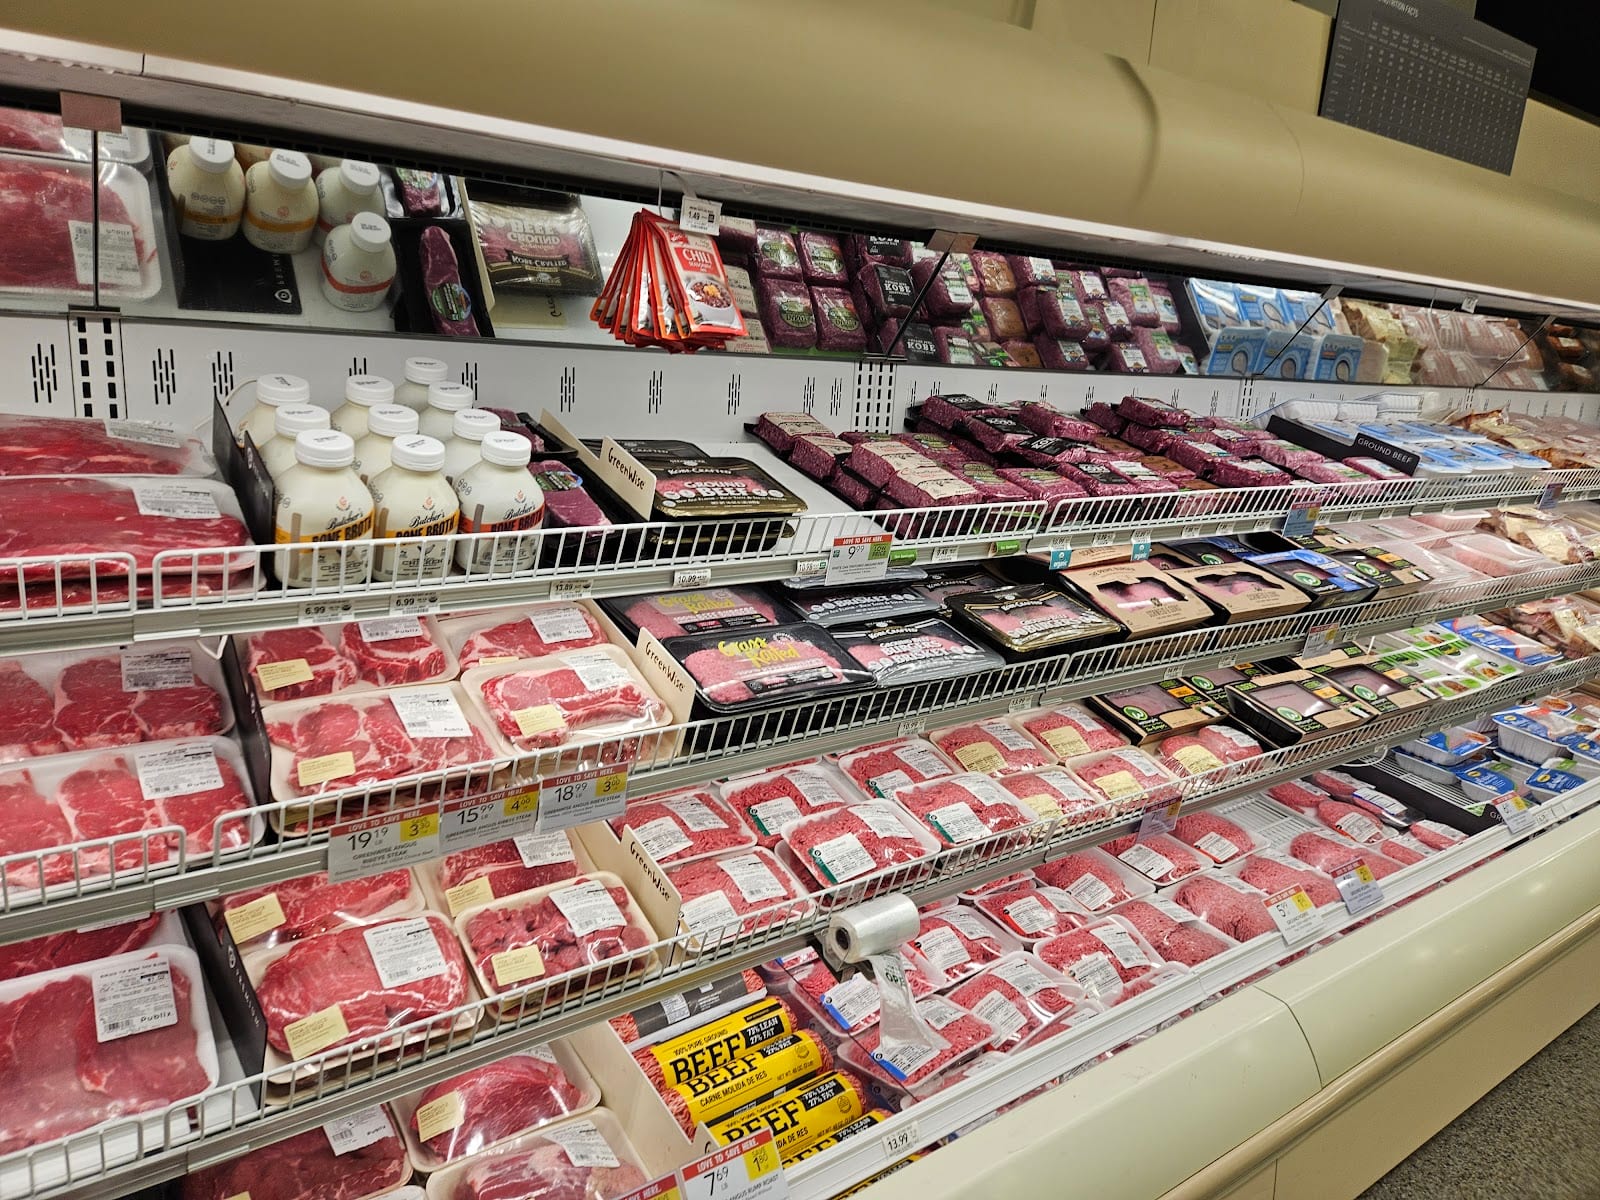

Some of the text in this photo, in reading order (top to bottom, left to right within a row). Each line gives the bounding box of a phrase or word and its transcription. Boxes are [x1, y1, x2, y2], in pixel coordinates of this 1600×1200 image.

[682, 248, 712, 264] CHILI
[1358, 438, 1412, 464] GROUND BEEF
[608, 447, 646, 490] GreenWise
[696, 487, 748, 496] BEEF
[409, 509, 445, 528] Butcher's
[504, 501, 536, 520] Butcher's
[426, 516, 456, 536] BROTH
[396, 598, 414, 606] 6.99
[305, 607, 325, 615] 6.99
[884, 641, 942, 655] BURGERS
[894, 650, 950, 663] BRISKET
[645, 640, 686, 692] GreenWise
[584, 771, 597, 779] SAVE
[600, 768, 615, 776] HERE.
[460, 800, 476, 808] LOVE
[490, 792, 505, 800] SAVE
[508, 788, 525, 796] HERE.
[348, 823, 367, 832] LOVE
[383, 815, 400, 824] SAVE
[403, 811, 423, 819] HERE.
[393, 841, 417, 850] ANGUS
[387, 850, 408, 859] STEAK
[630, 841, 670, 901] GreenWise
[886, 972, 906, 987] OPE
[760, 1017, 778, 1031] LEAN
[749, 1028, 775, 1045] 27% FAT
[670, 1034, 741, 1084] BEEF
[686, 1054, 759, 1098] BEEF
[700, 1071, 768, 1107] CARNE MOLIDA DE RES
[817, 1081, 837, 1095] LEAN
[823, 1088, 835, 1101] FAT
[788, 1133, 795, 1141] DE
[796, 1127, 808, 1139] RES
[888, 1133, 908, 1151] 13.99
[697, 1158, 713, 1171] LOVE
[715, 1153, 724, 1164] TO
[725, 1145, 741, 1160] SAVE
[742, 1138, 759, 1151] HERE.
[763, 1174, 779, 1187] ROAST
[643, 1184, 662, 1200] HERE.
